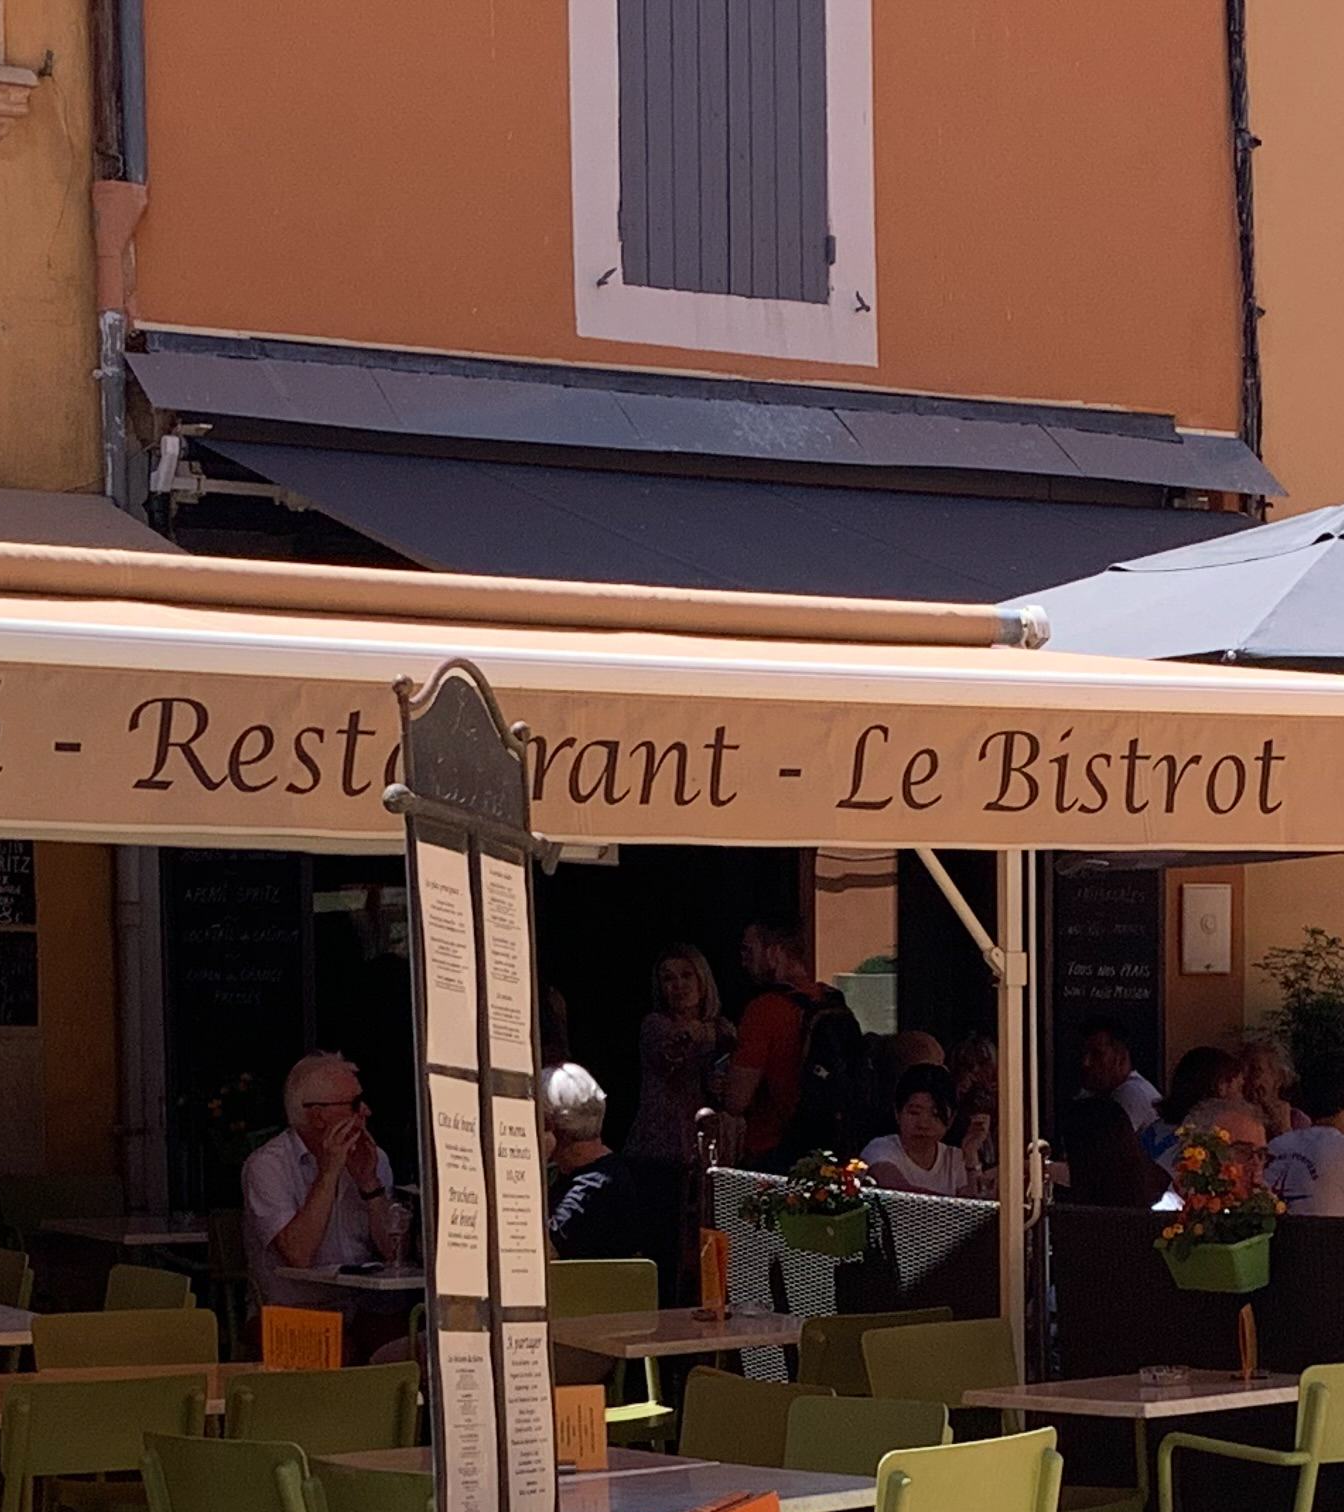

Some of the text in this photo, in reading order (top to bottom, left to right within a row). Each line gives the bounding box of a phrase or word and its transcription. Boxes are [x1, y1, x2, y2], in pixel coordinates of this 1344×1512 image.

[128, 696, 740, 809] Restrant
[836, 724, 943, 812] Le
[977, 727, 1286, 815] Bistrot
